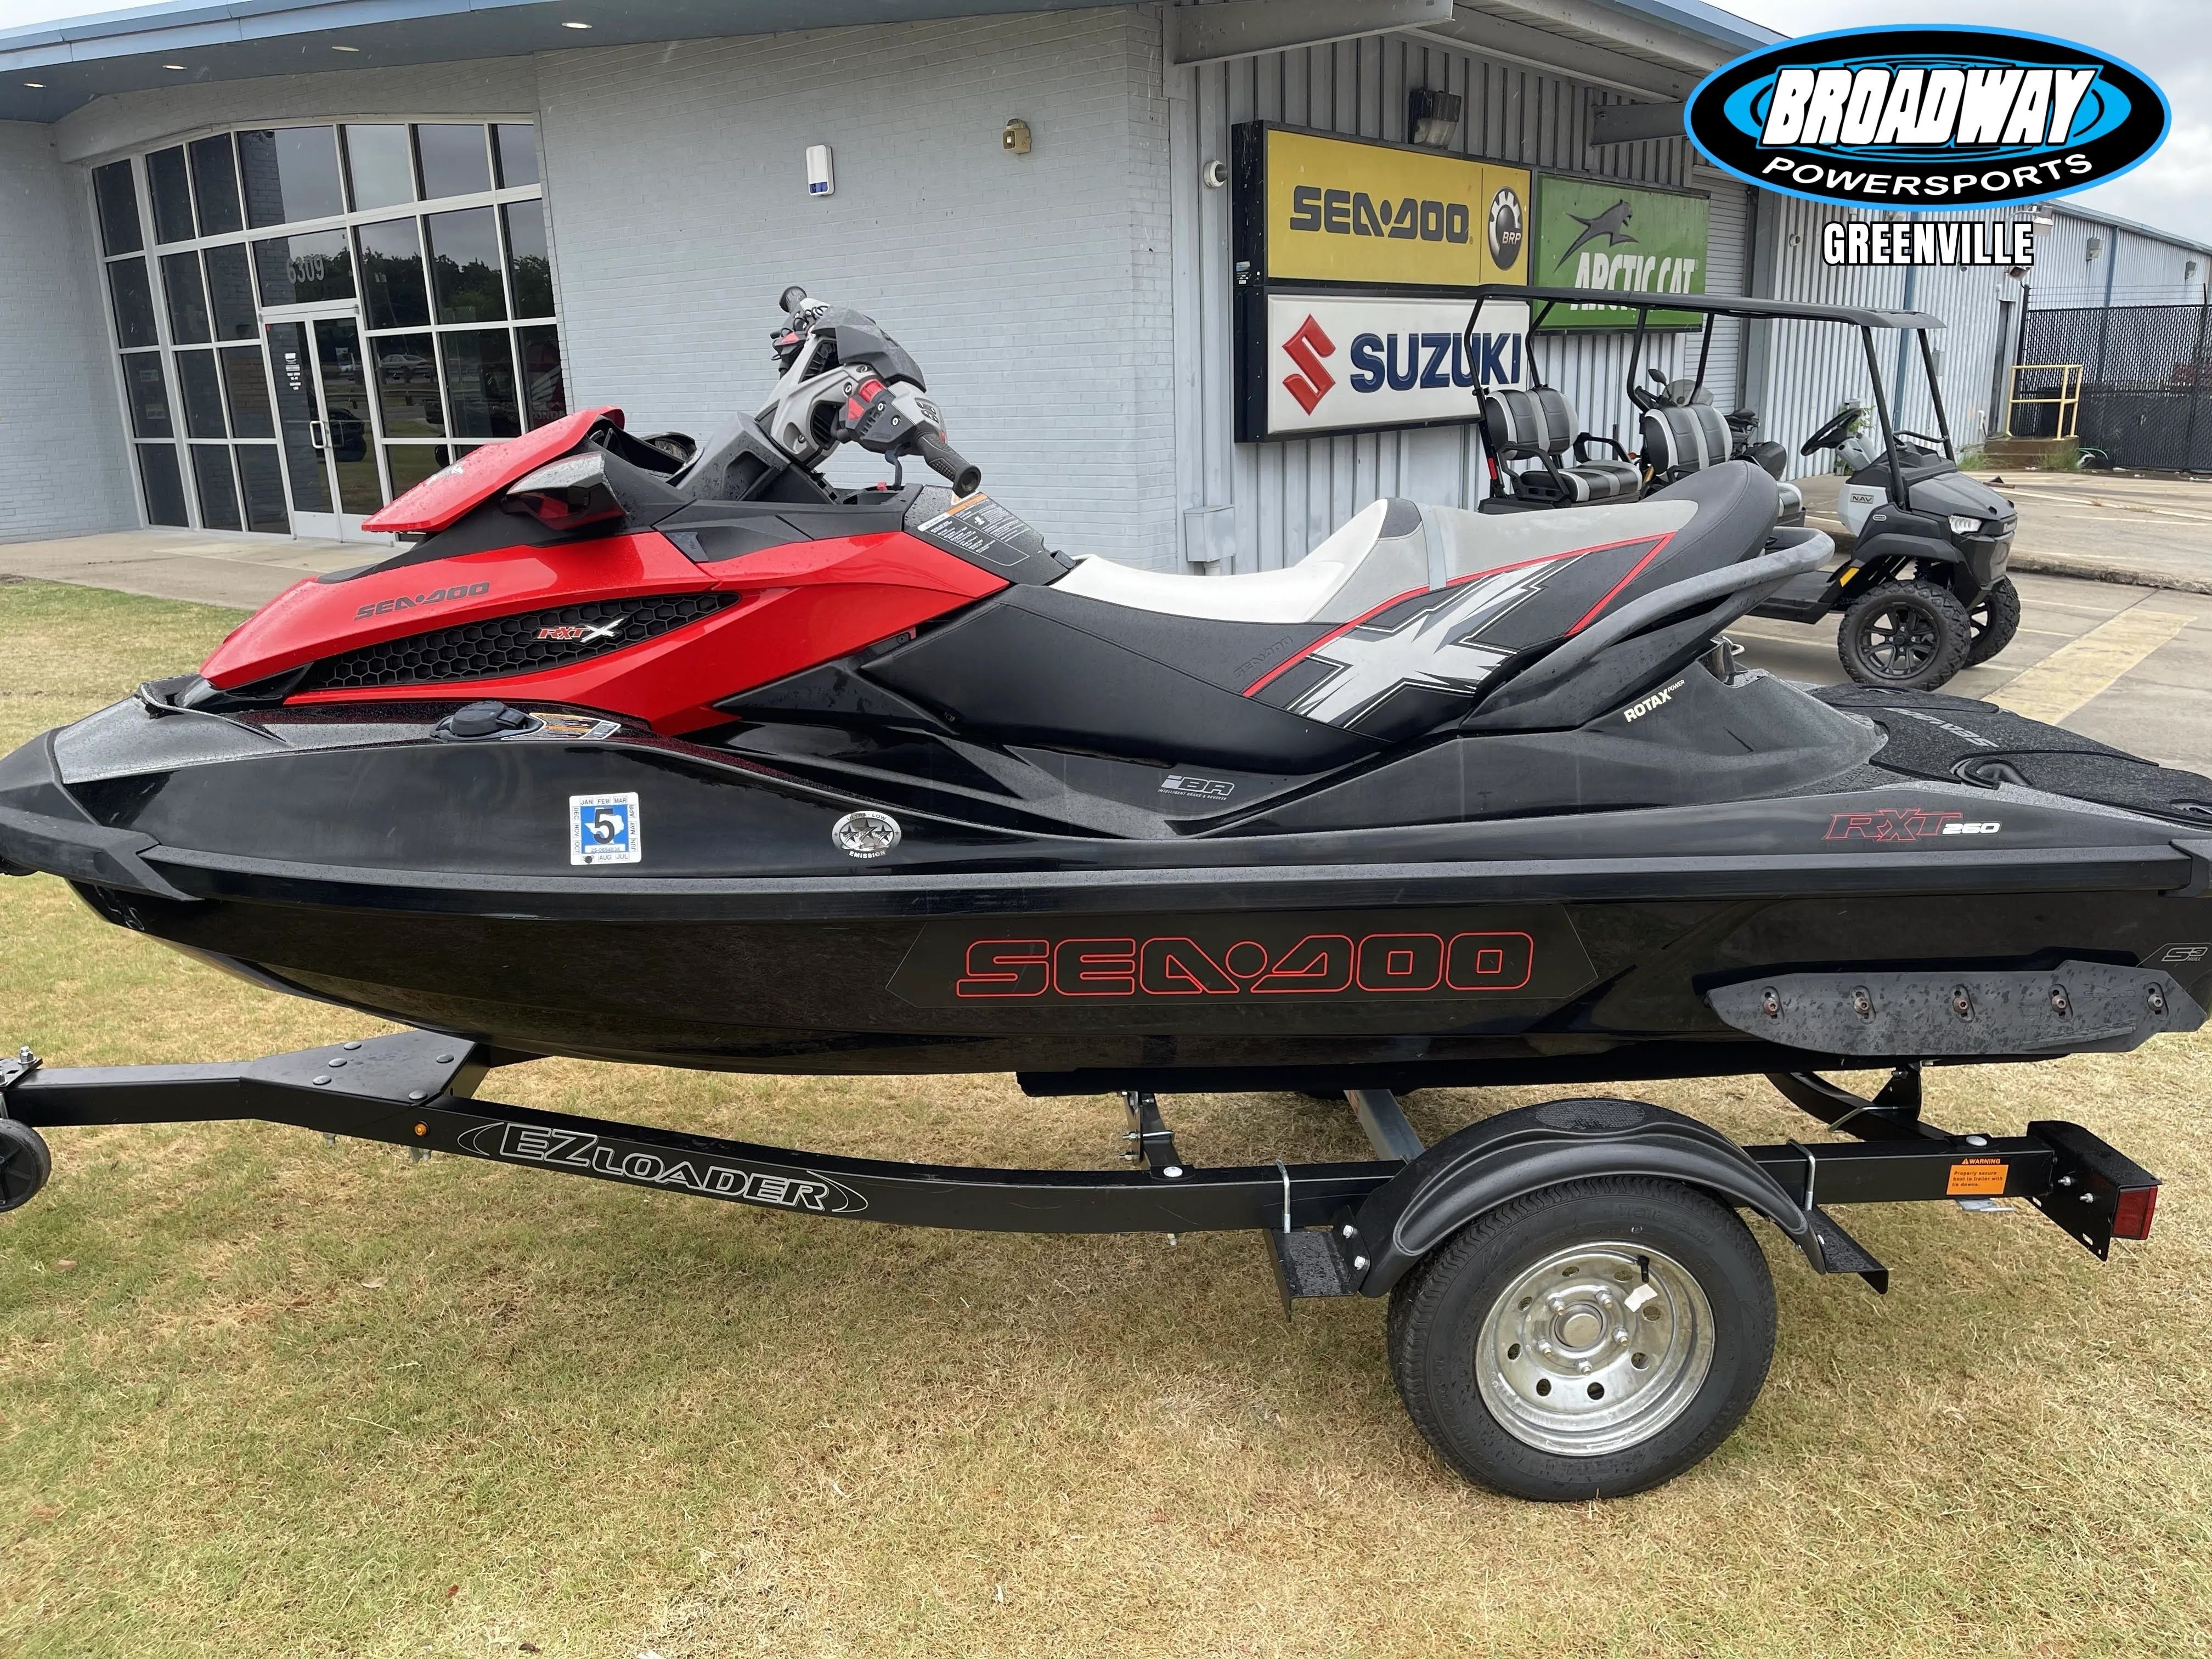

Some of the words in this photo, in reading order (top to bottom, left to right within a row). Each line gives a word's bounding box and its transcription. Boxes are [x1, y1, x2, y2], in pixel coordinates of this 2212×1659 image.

[1502, 231, 1521, 245] BRP
[286, 254, 324, 284] 6309
[1570, 252, 1656, 311] ARCTIC
[1350, 333, 1522, 393] SUZUKI
[1624, 689, 1672, 723] ROTAX
[1668, 679, 1685, 693] POWER
[594, 807, 615, 844] 5
[1824, 808, 1963, 842] RXT
[1942, 822, 2001, 835] 260
[849, 850, 886, 859] EMISSION
